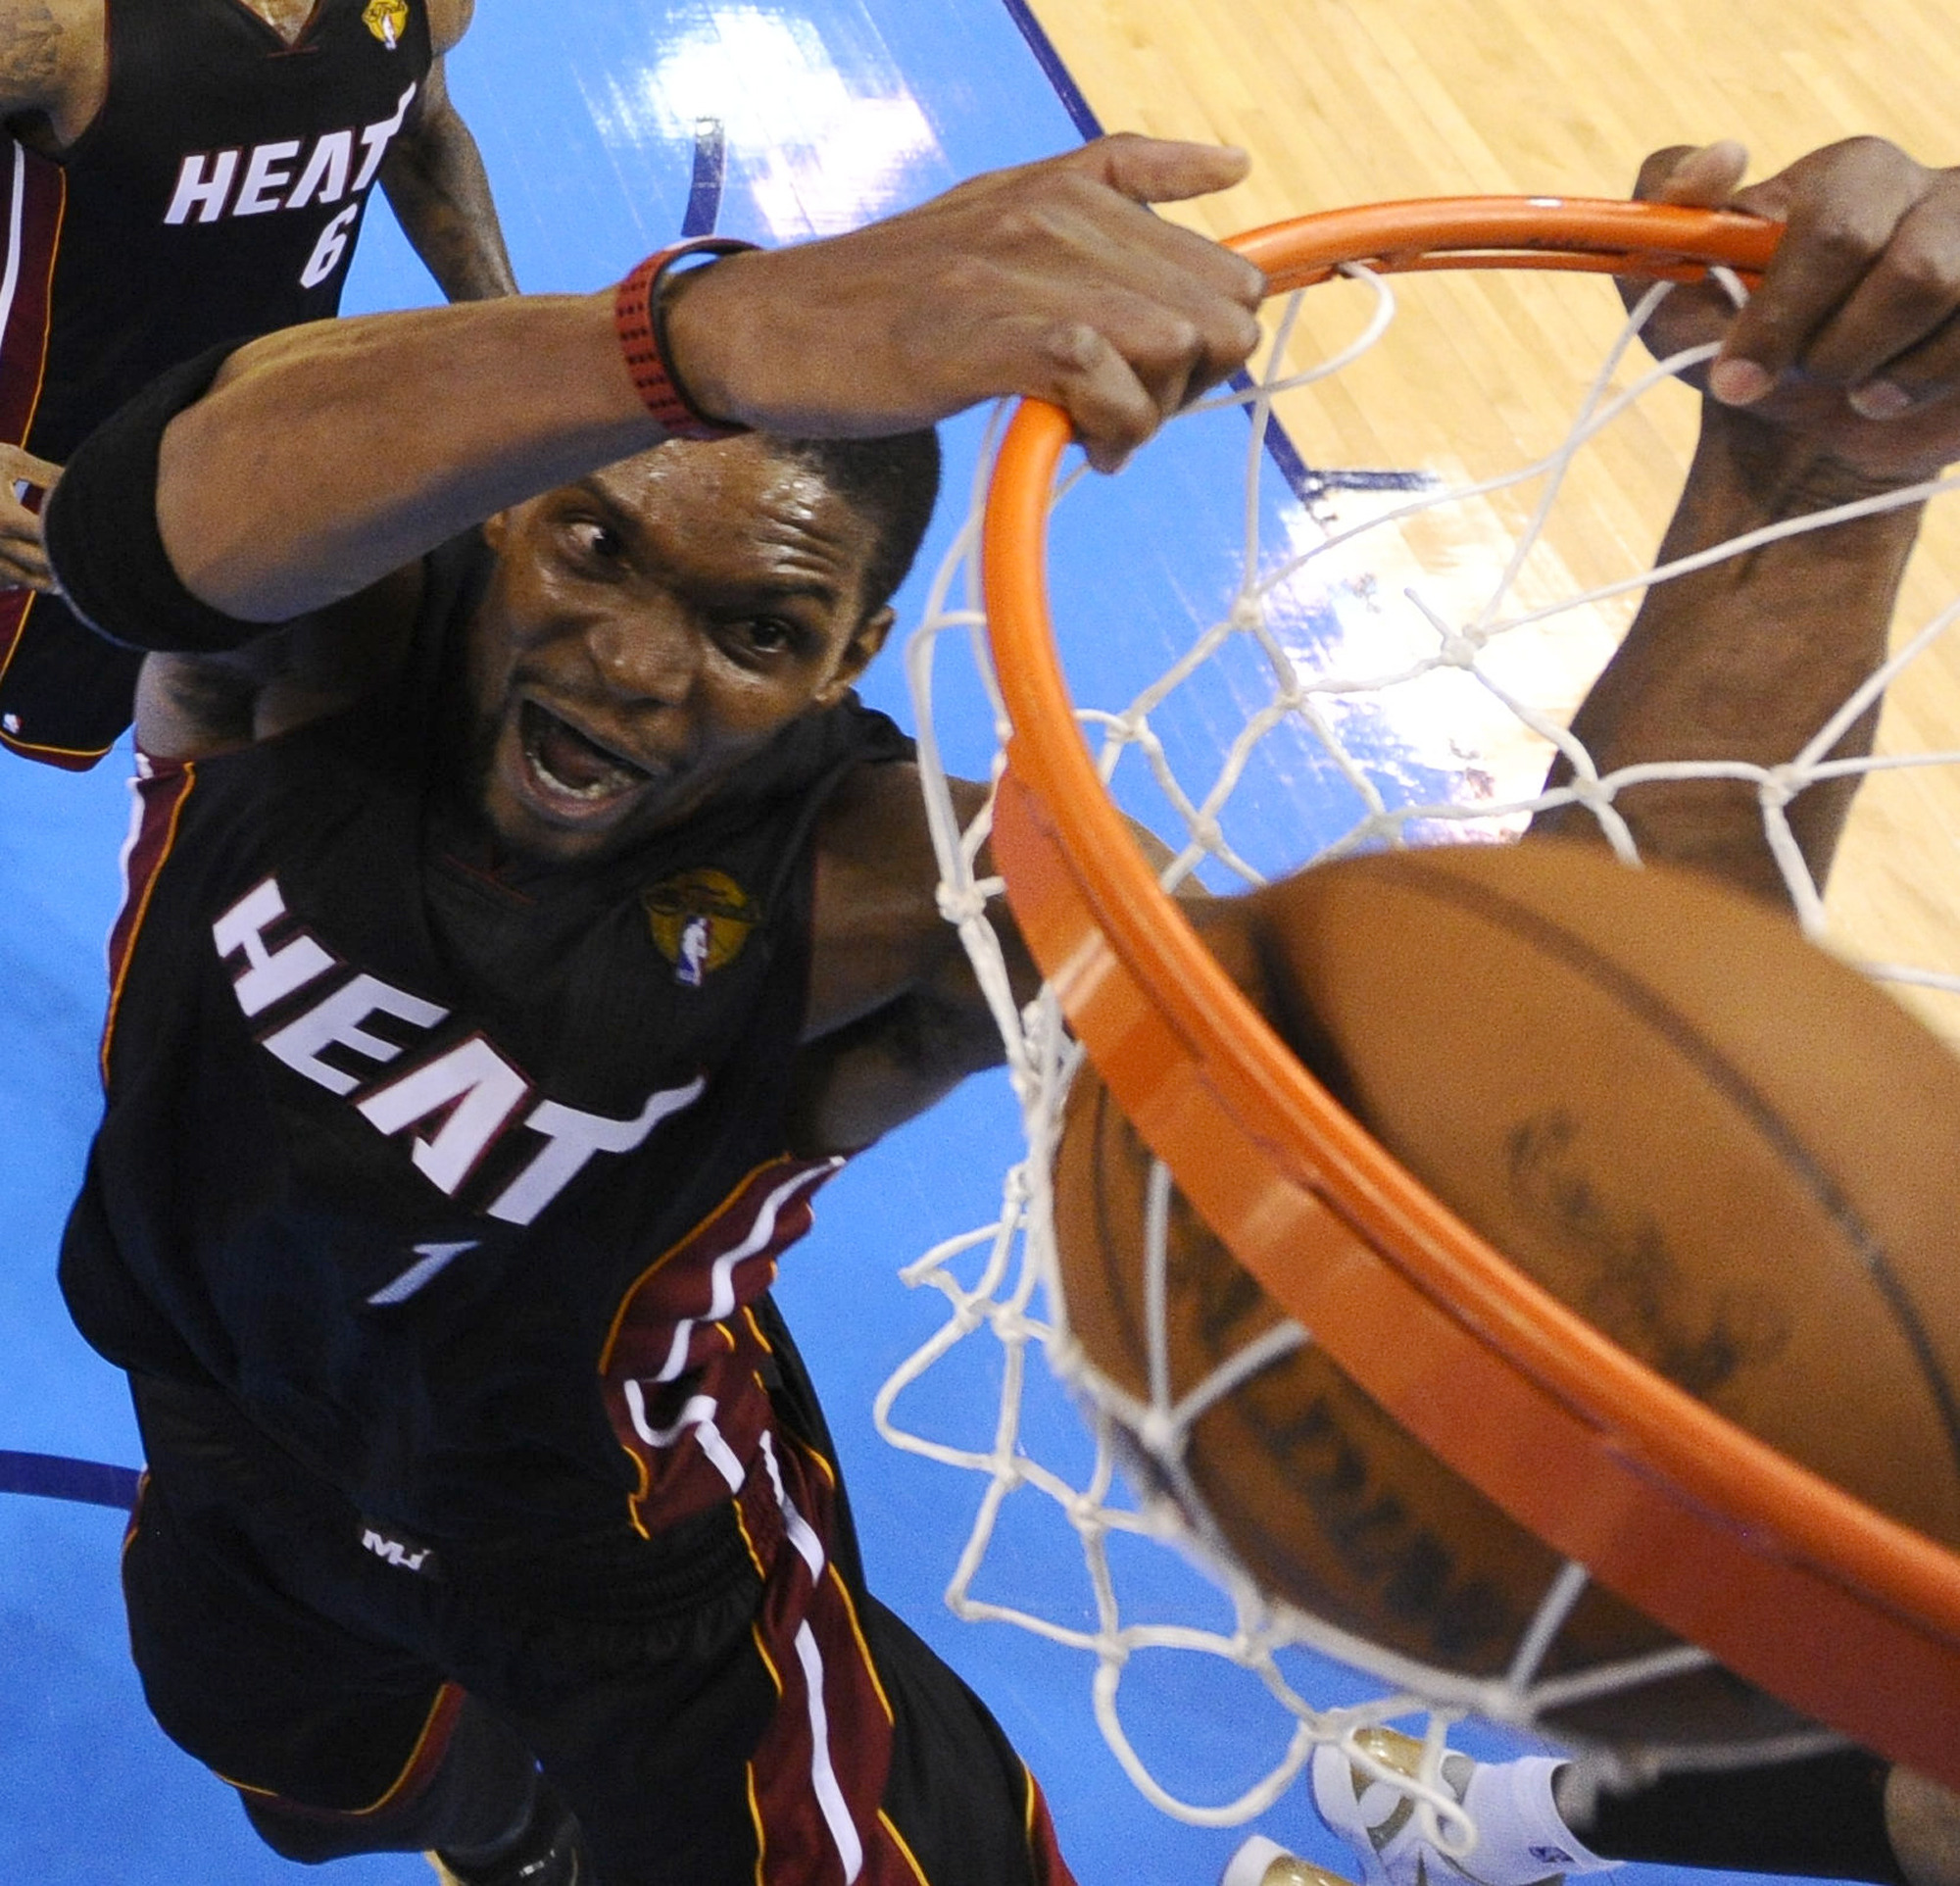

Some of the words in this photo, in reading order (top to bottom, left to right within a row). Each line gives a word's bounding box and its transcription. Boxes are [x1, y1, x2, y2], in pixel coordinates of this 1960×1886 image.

[165, 81, 416, 224] HEAT
[300, 203, 358, 289] 6
[212, 877, 705, 1226] HEAT
[368, 1241, 476, 1304] 1
